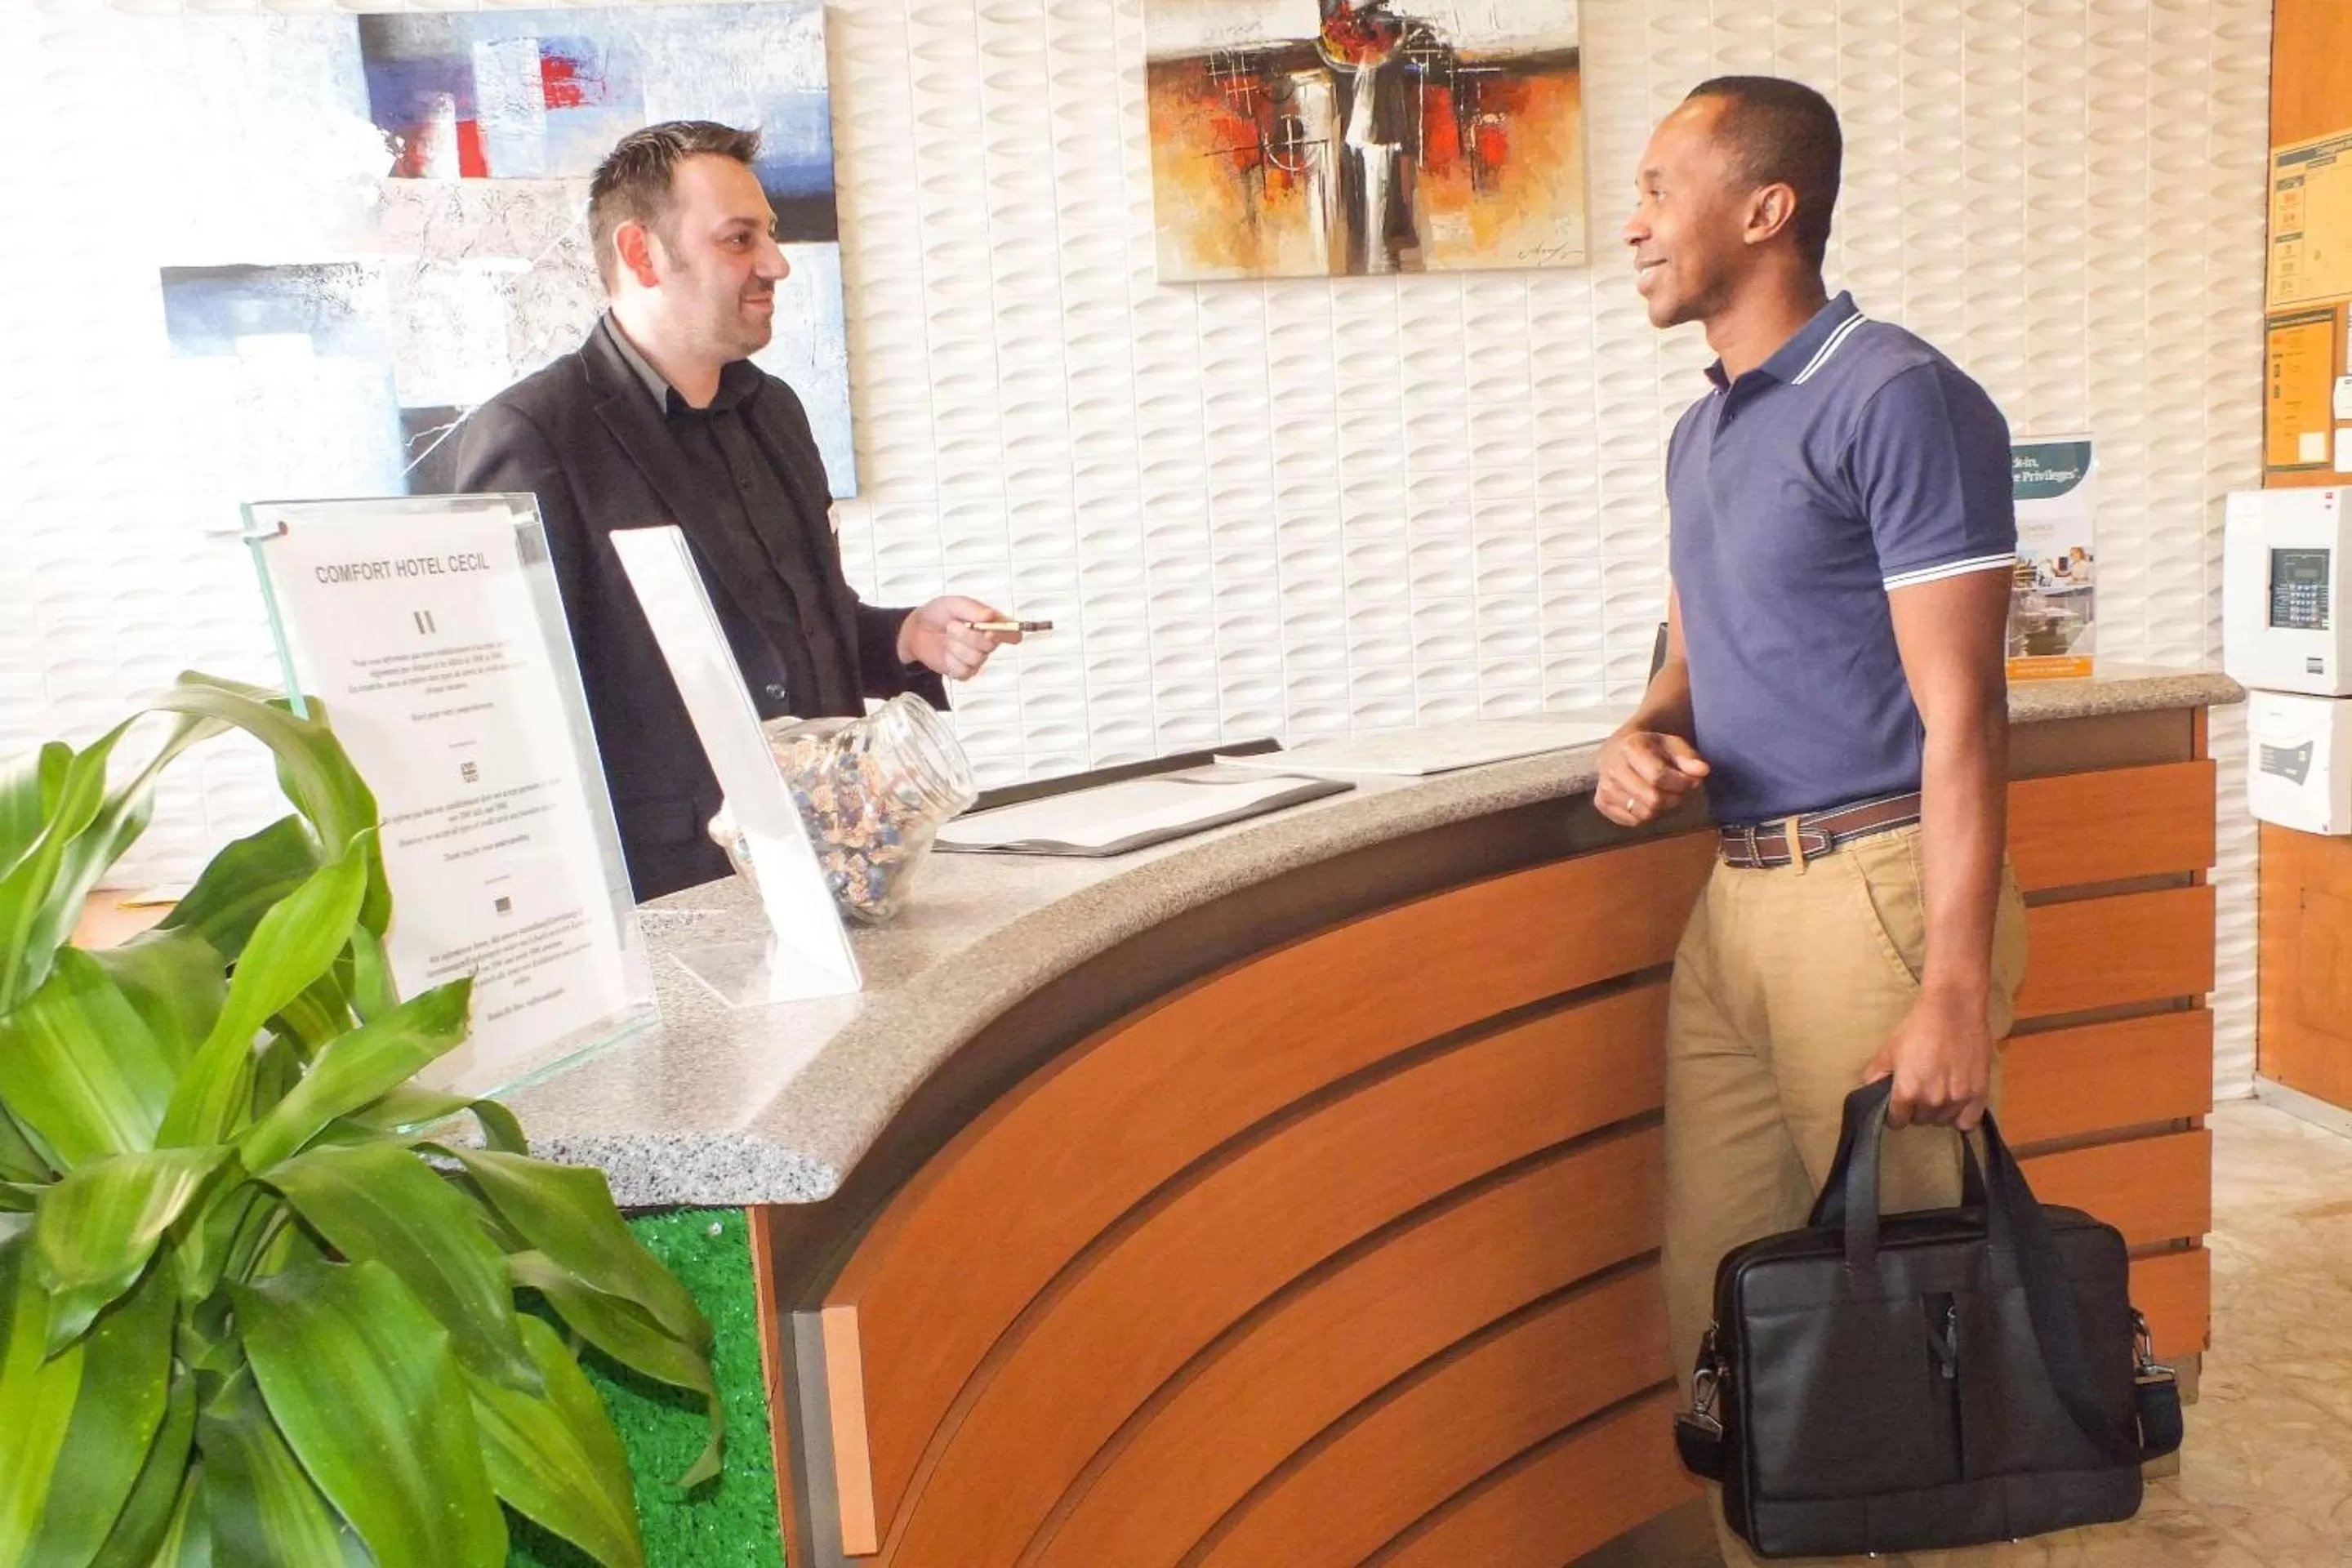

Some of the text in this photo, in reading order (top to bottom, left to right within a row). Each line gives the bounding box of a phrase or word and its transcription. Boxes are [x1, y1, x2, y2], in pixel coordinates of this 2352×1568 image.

[315, 553, 489, 584] COMFORT HOTEL CECIL
